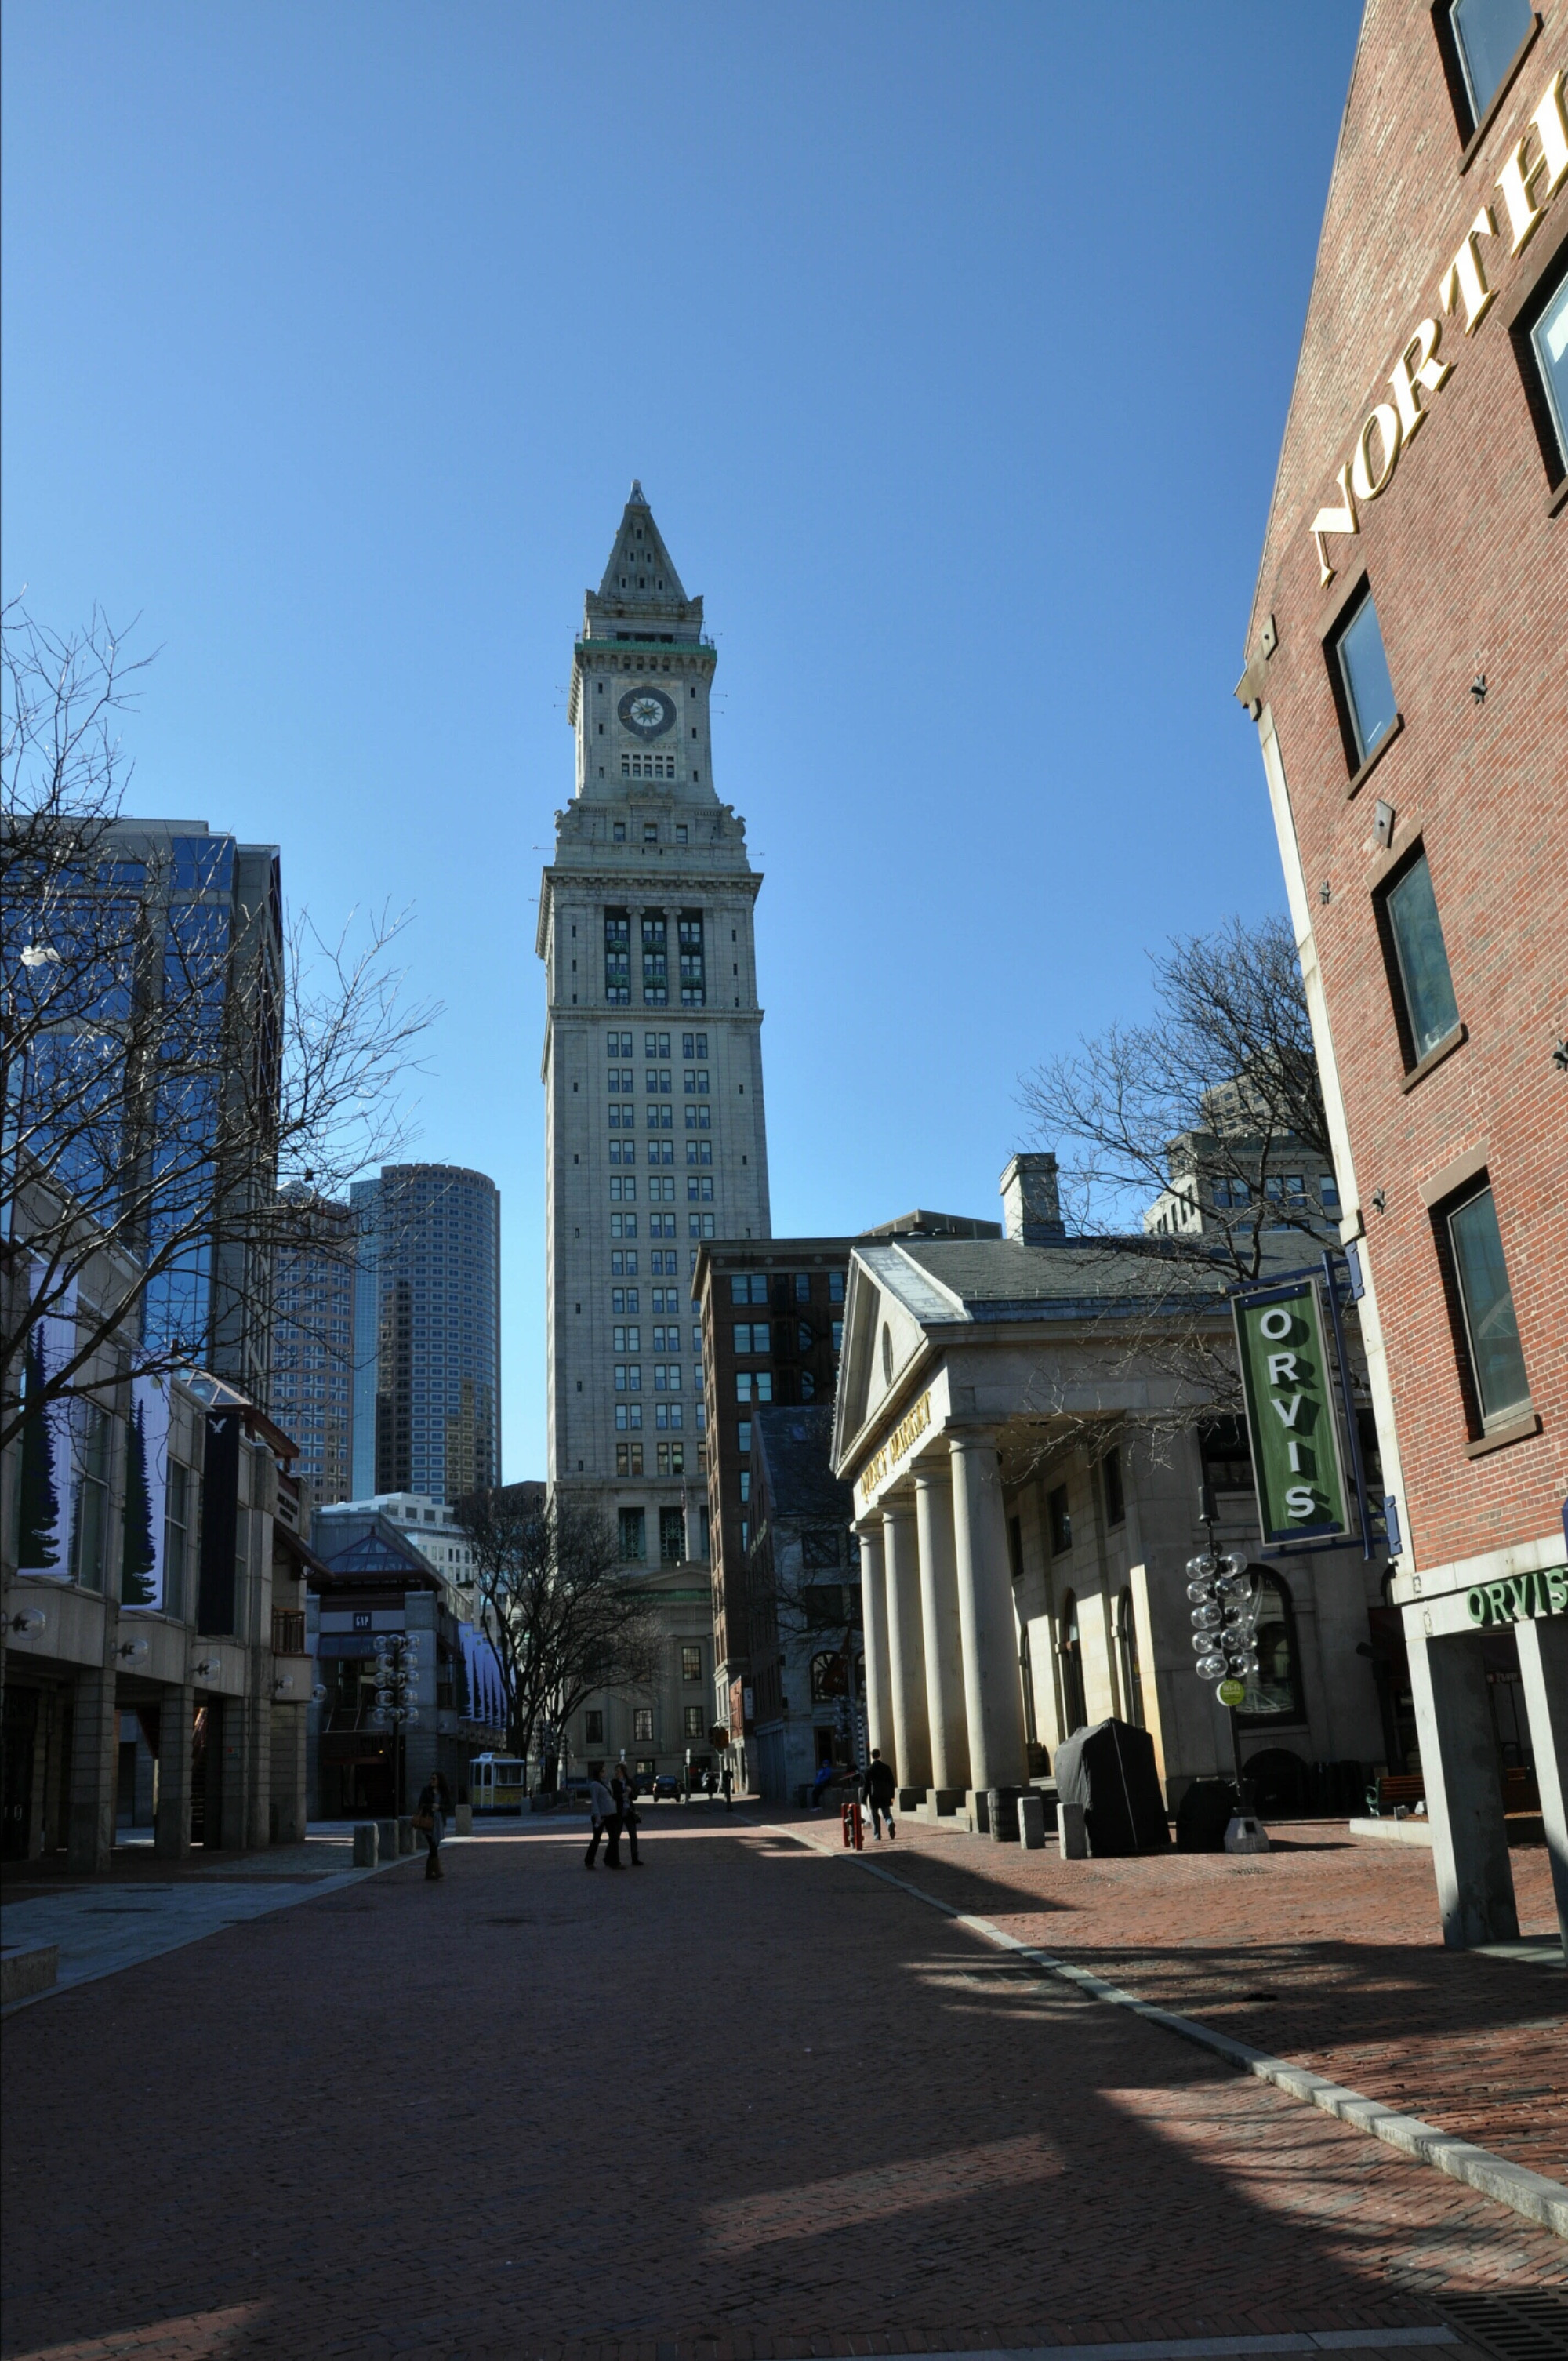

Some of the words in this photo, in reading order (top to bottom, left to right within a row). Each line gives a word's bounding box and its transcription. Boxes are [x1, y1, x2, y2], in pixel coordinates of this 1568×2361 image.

[1308, 70, 1568, 589] NORTH
[887, 1389, 931, 1466] MARKET
[1259, 1308, 1317, 1520] ORVIS
[355, 1615, 369, 1628] GAP
[1466, 1567, 1568, 1625] ORVIS
